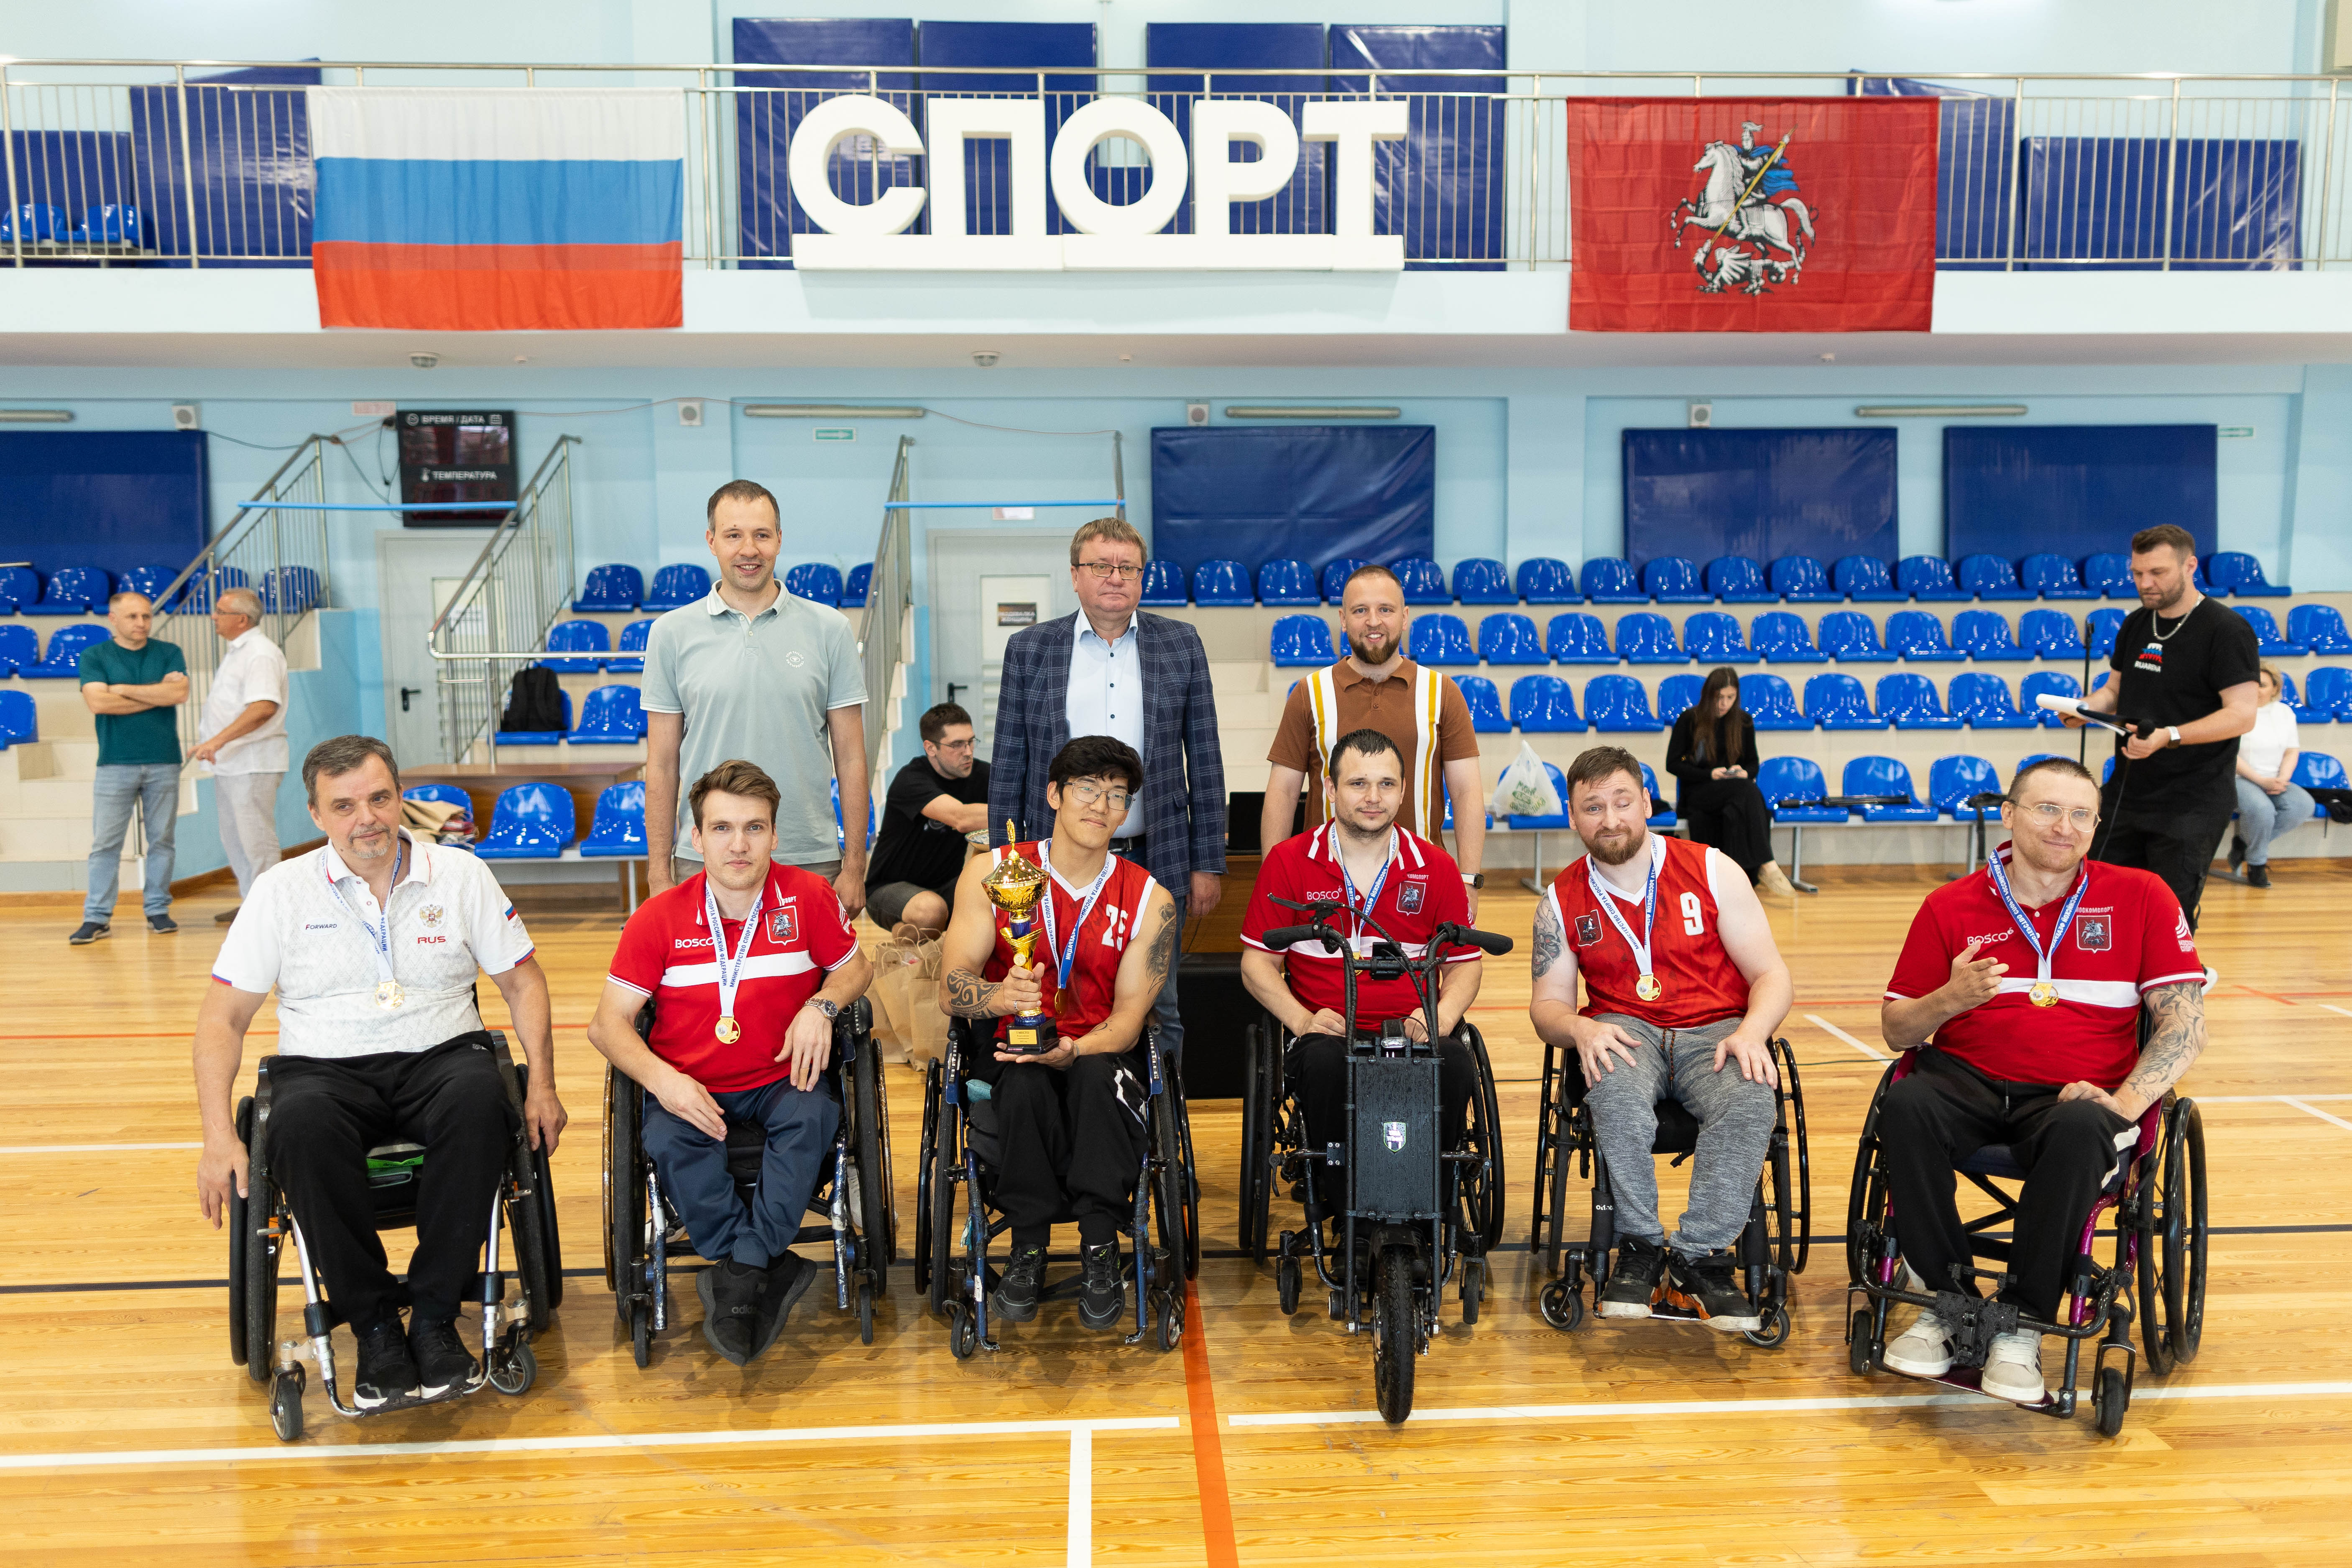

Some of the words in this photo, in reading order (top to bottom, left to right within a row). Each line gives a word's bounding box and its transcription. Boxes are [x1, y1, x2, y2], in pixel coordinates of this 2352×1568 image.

[788, 94, 1409, 238] СПОРТ
[421, 414, 454, 424] ВРЕМЯ
[460, 414, 485, 425] ДАТА
[432, 471, 497, 480] ТЕМПЕРАТУРА
[1091, 876, 1103, 896] СПОРТА
[1307, 891, 1340, 900] BOSCO
[1601, 895, 1615, 915] СПОРТА
[1680, 891, 1705, 937] 9
[380, 917, 388, 951] ФЕДЕРАЦИИ
[417, 936, 446, 944] RUS
[707, 898, 716, 917] СПОРТА
[712, 917, 725, 953] РОССИЙСКОЙ
[719, 953, 728, 986] ФЕДЕРАЦИИ
[1614, 914, 1640, 950] МИНИСТЕРСТВО
[1967, 932, 2008, 946] BOSCO
[675, 937, 715, 949] BOSCO
[729, 944, 746, 988] МИНИСТЕРСТВО
[742, 923, 753, 944] СПОРТА
